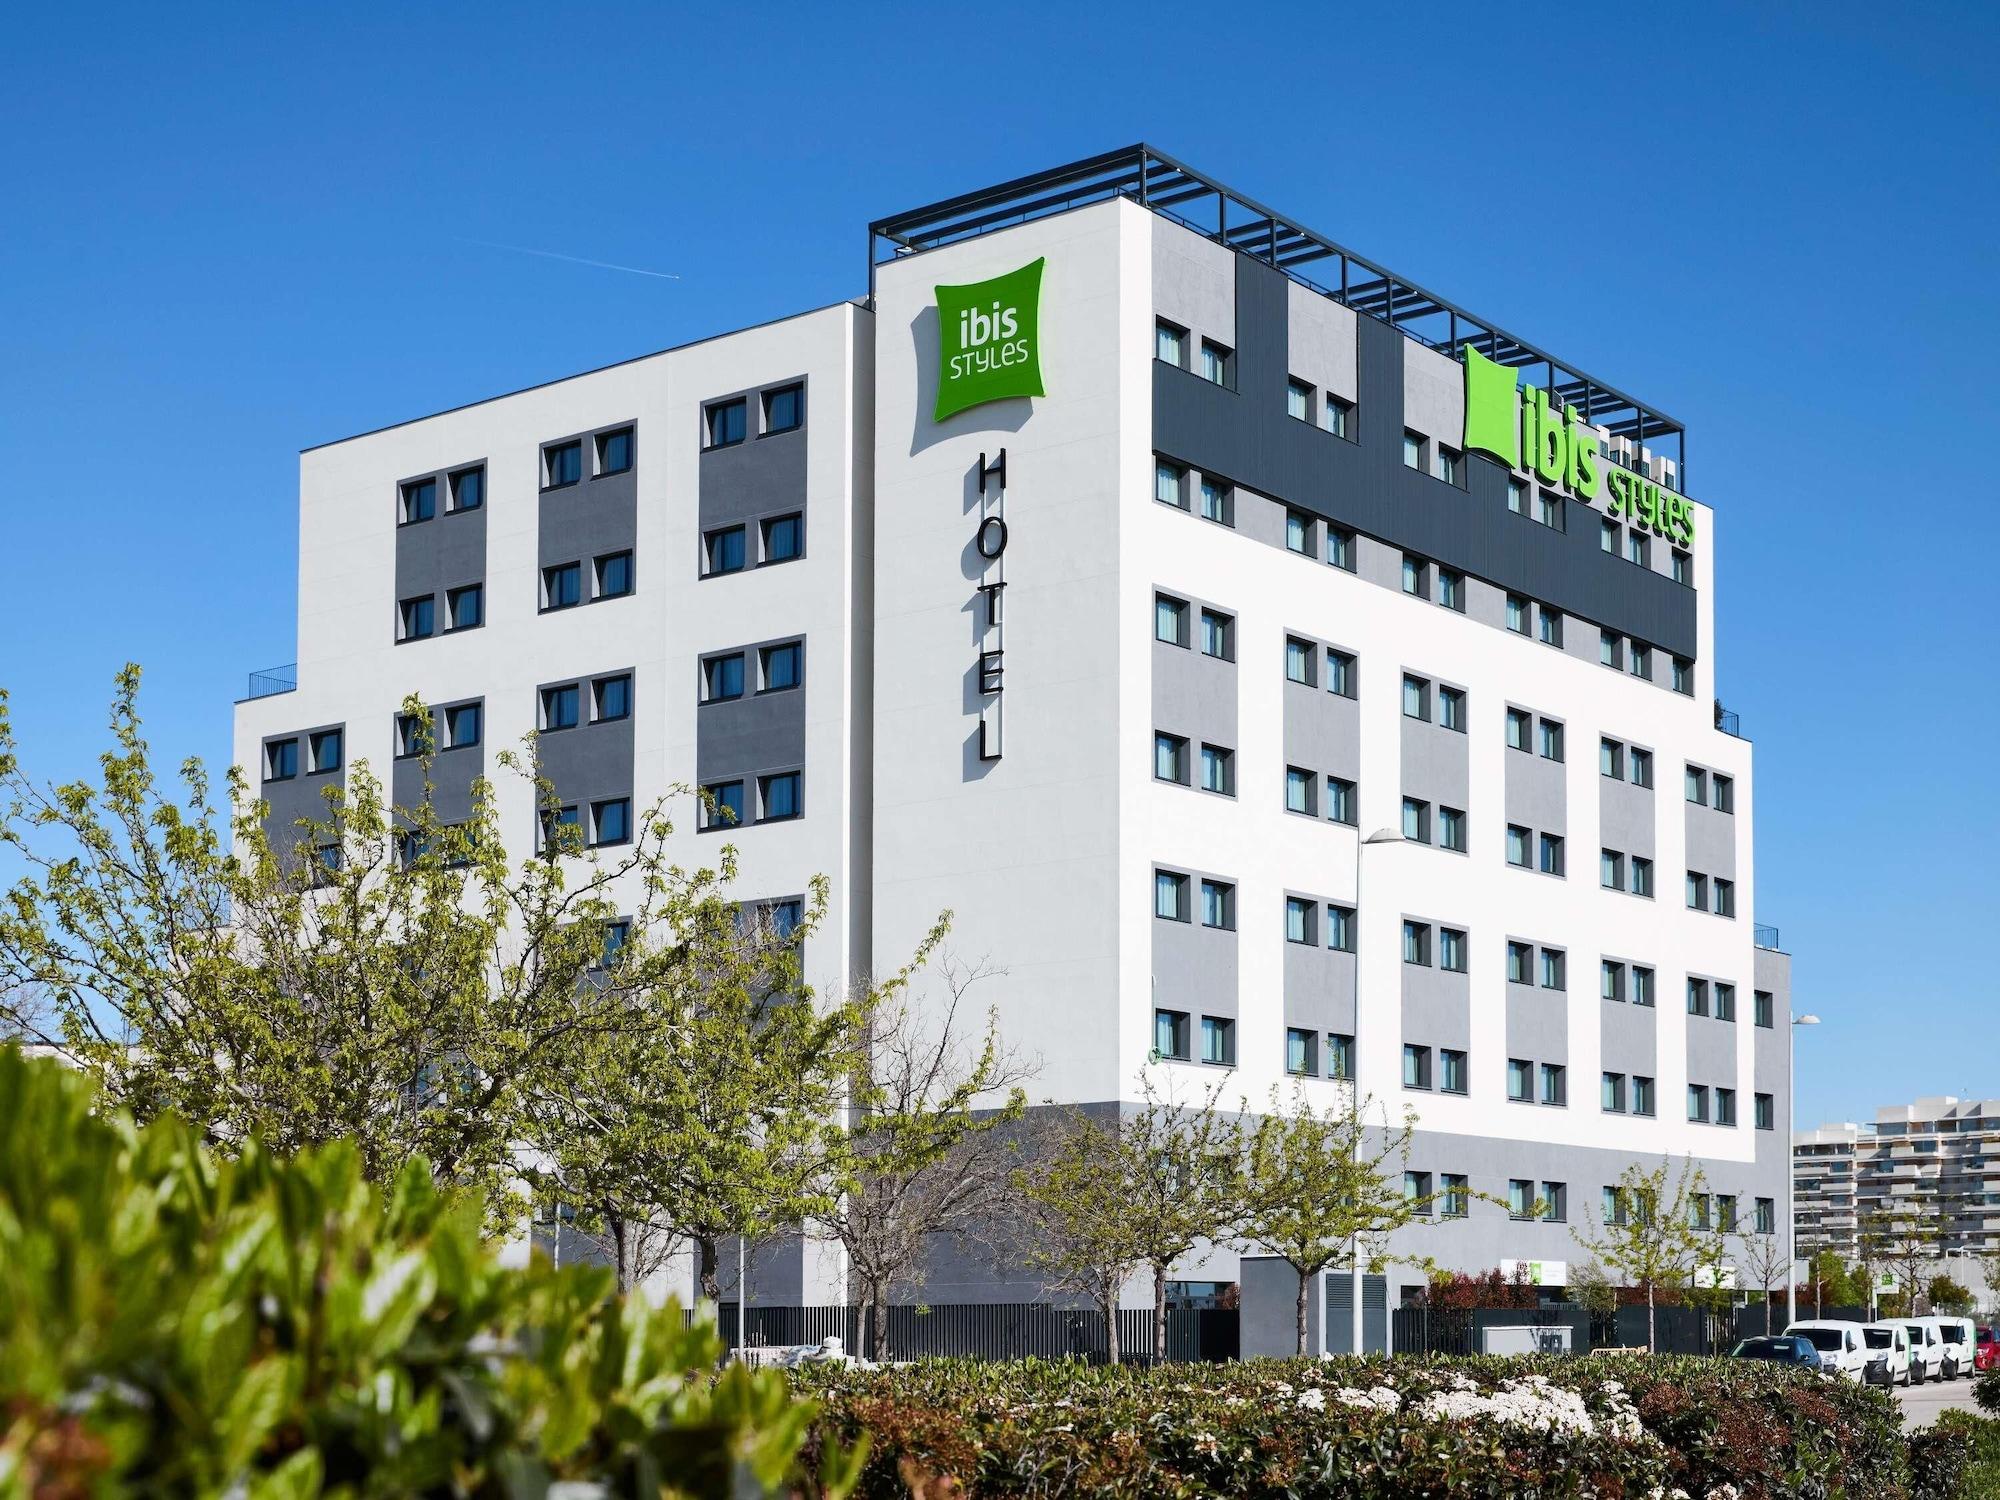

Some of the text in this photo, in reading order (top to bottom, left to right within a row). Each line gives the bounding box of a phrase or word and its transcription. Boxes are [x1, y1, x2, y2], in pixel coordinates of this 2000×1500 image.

[960, 301, 1018, 349] ibis
[1522, 383, 1598, 499] ibis
[977, 448, 1008, 761] HOTEL
